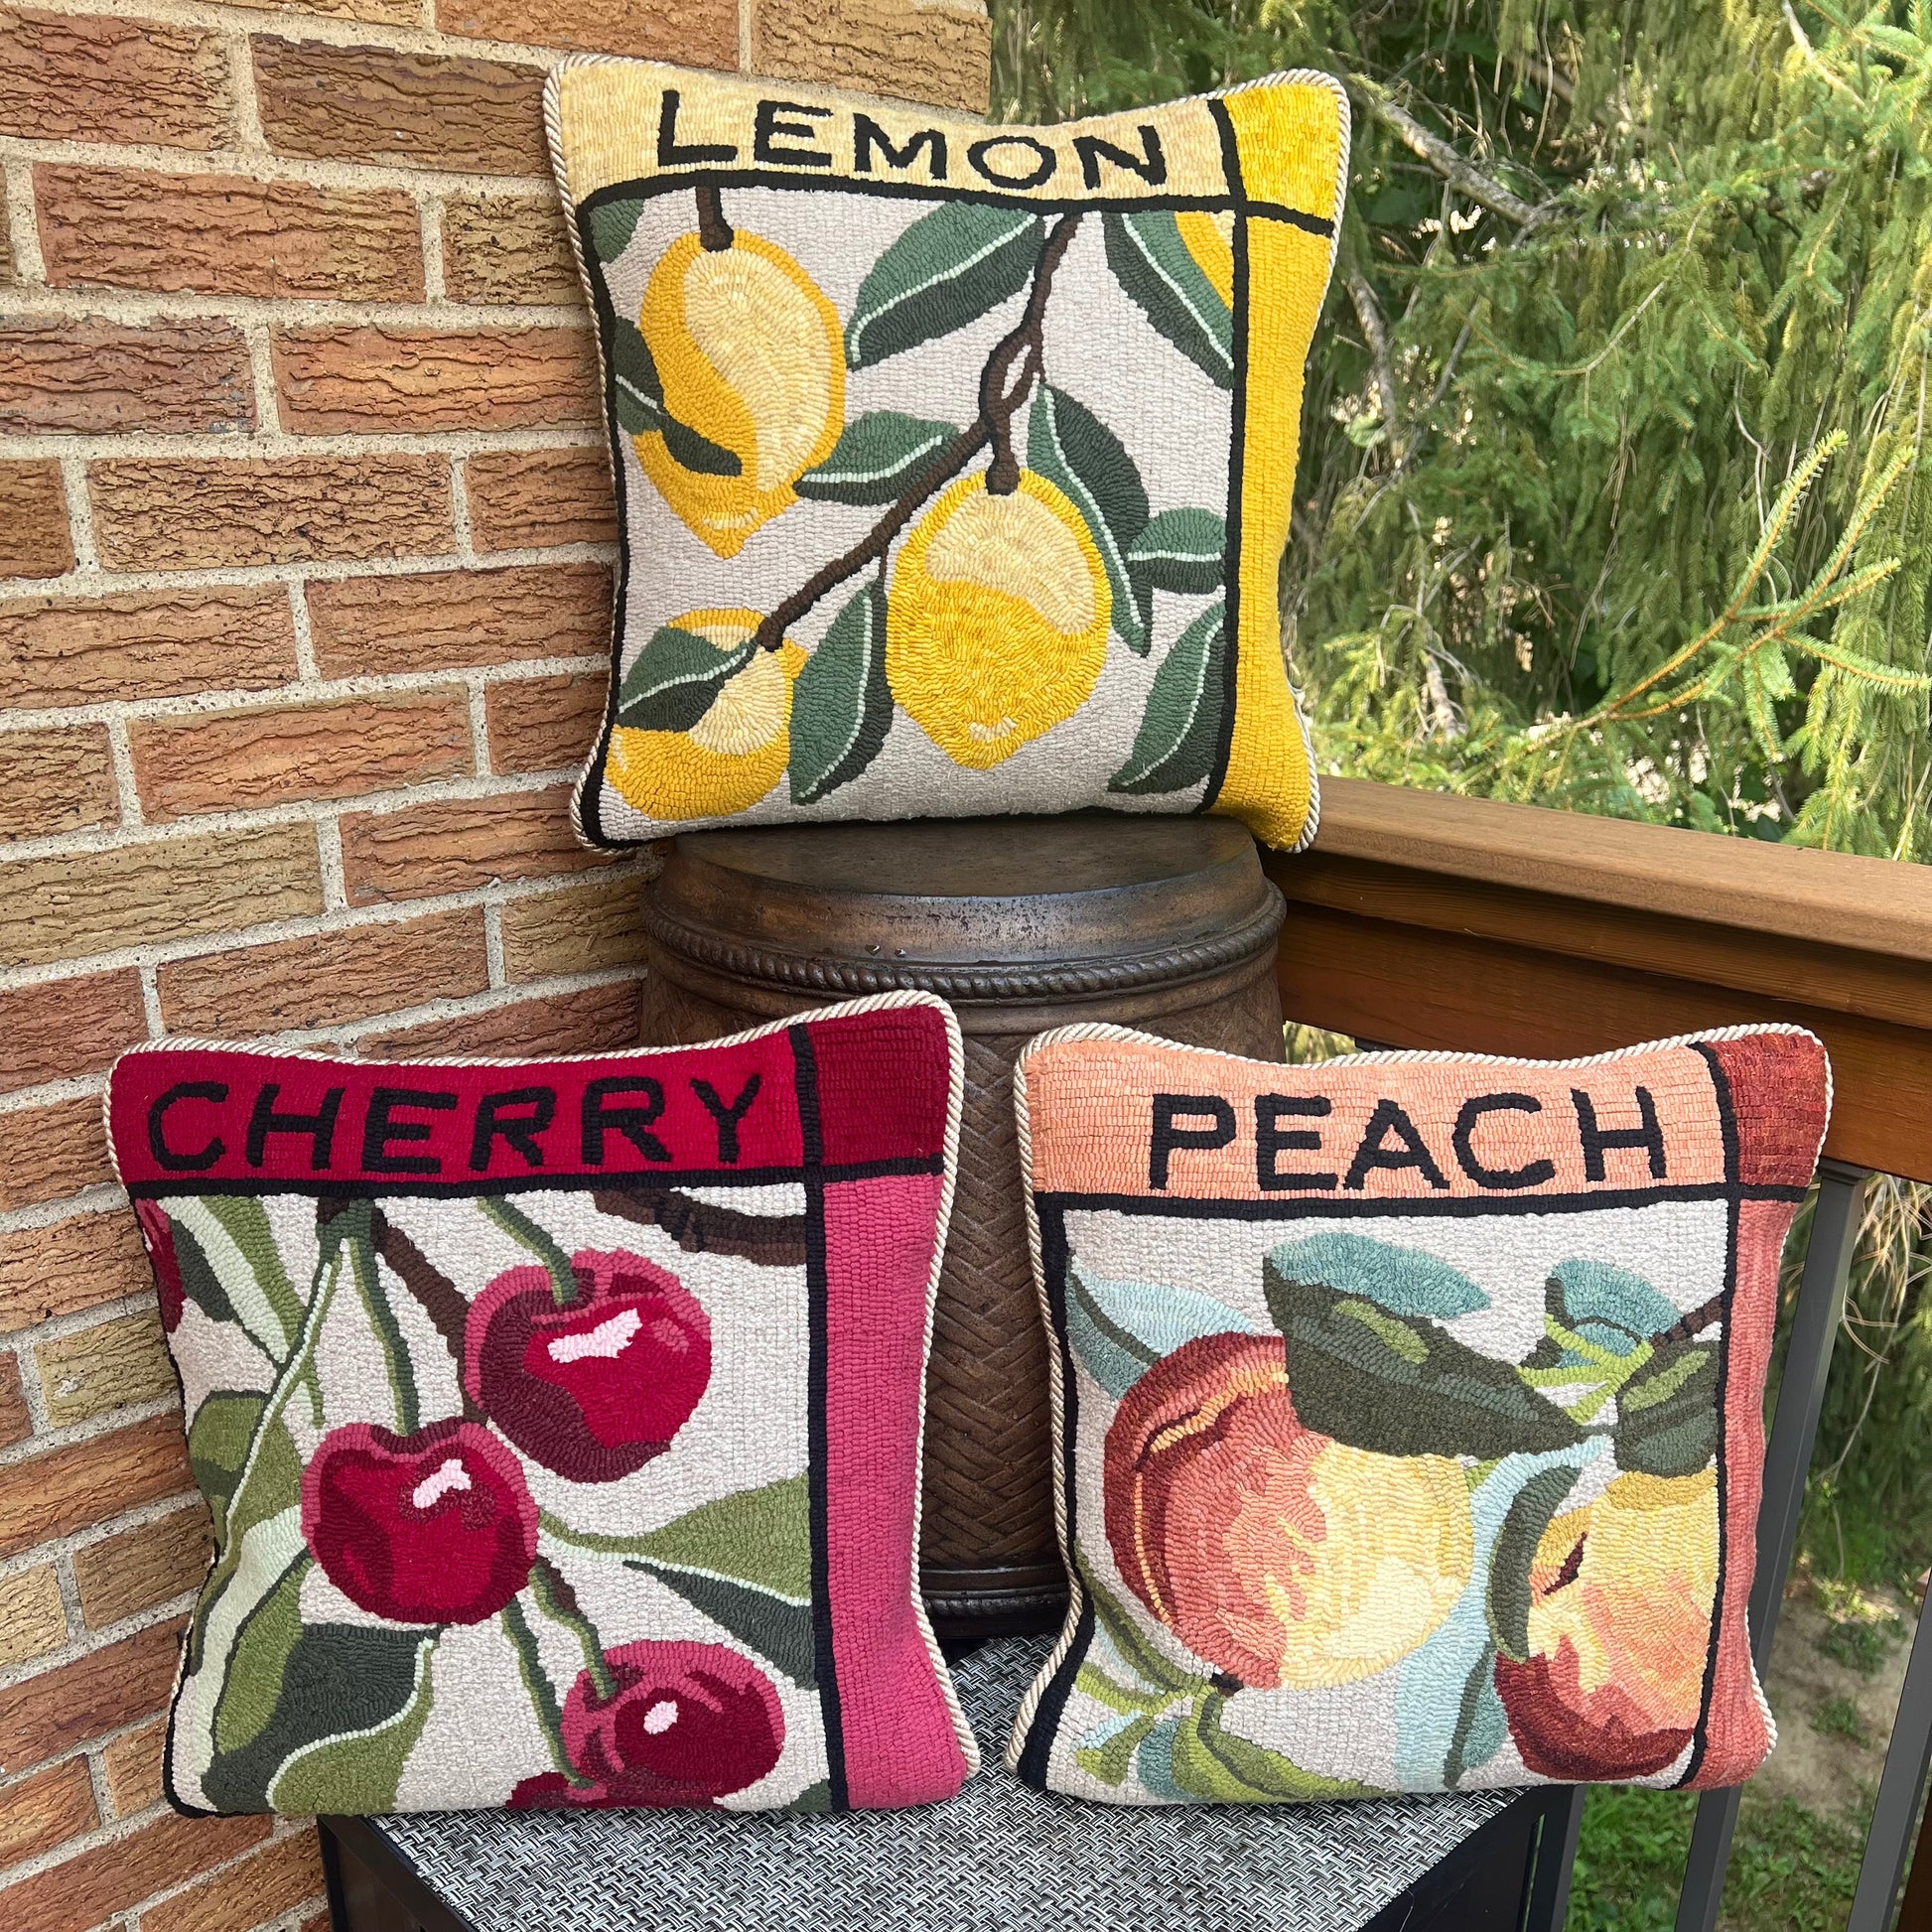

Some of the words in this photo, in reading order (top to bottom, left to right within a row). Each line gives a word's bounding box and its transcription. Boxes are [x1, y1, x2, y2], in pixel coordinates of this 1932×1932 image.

[656, 89, 1168, 190] LEMON
[147, 1073, 762, 1173] CHERRY
[1148, 1086, 1667, 1191] PEACH
